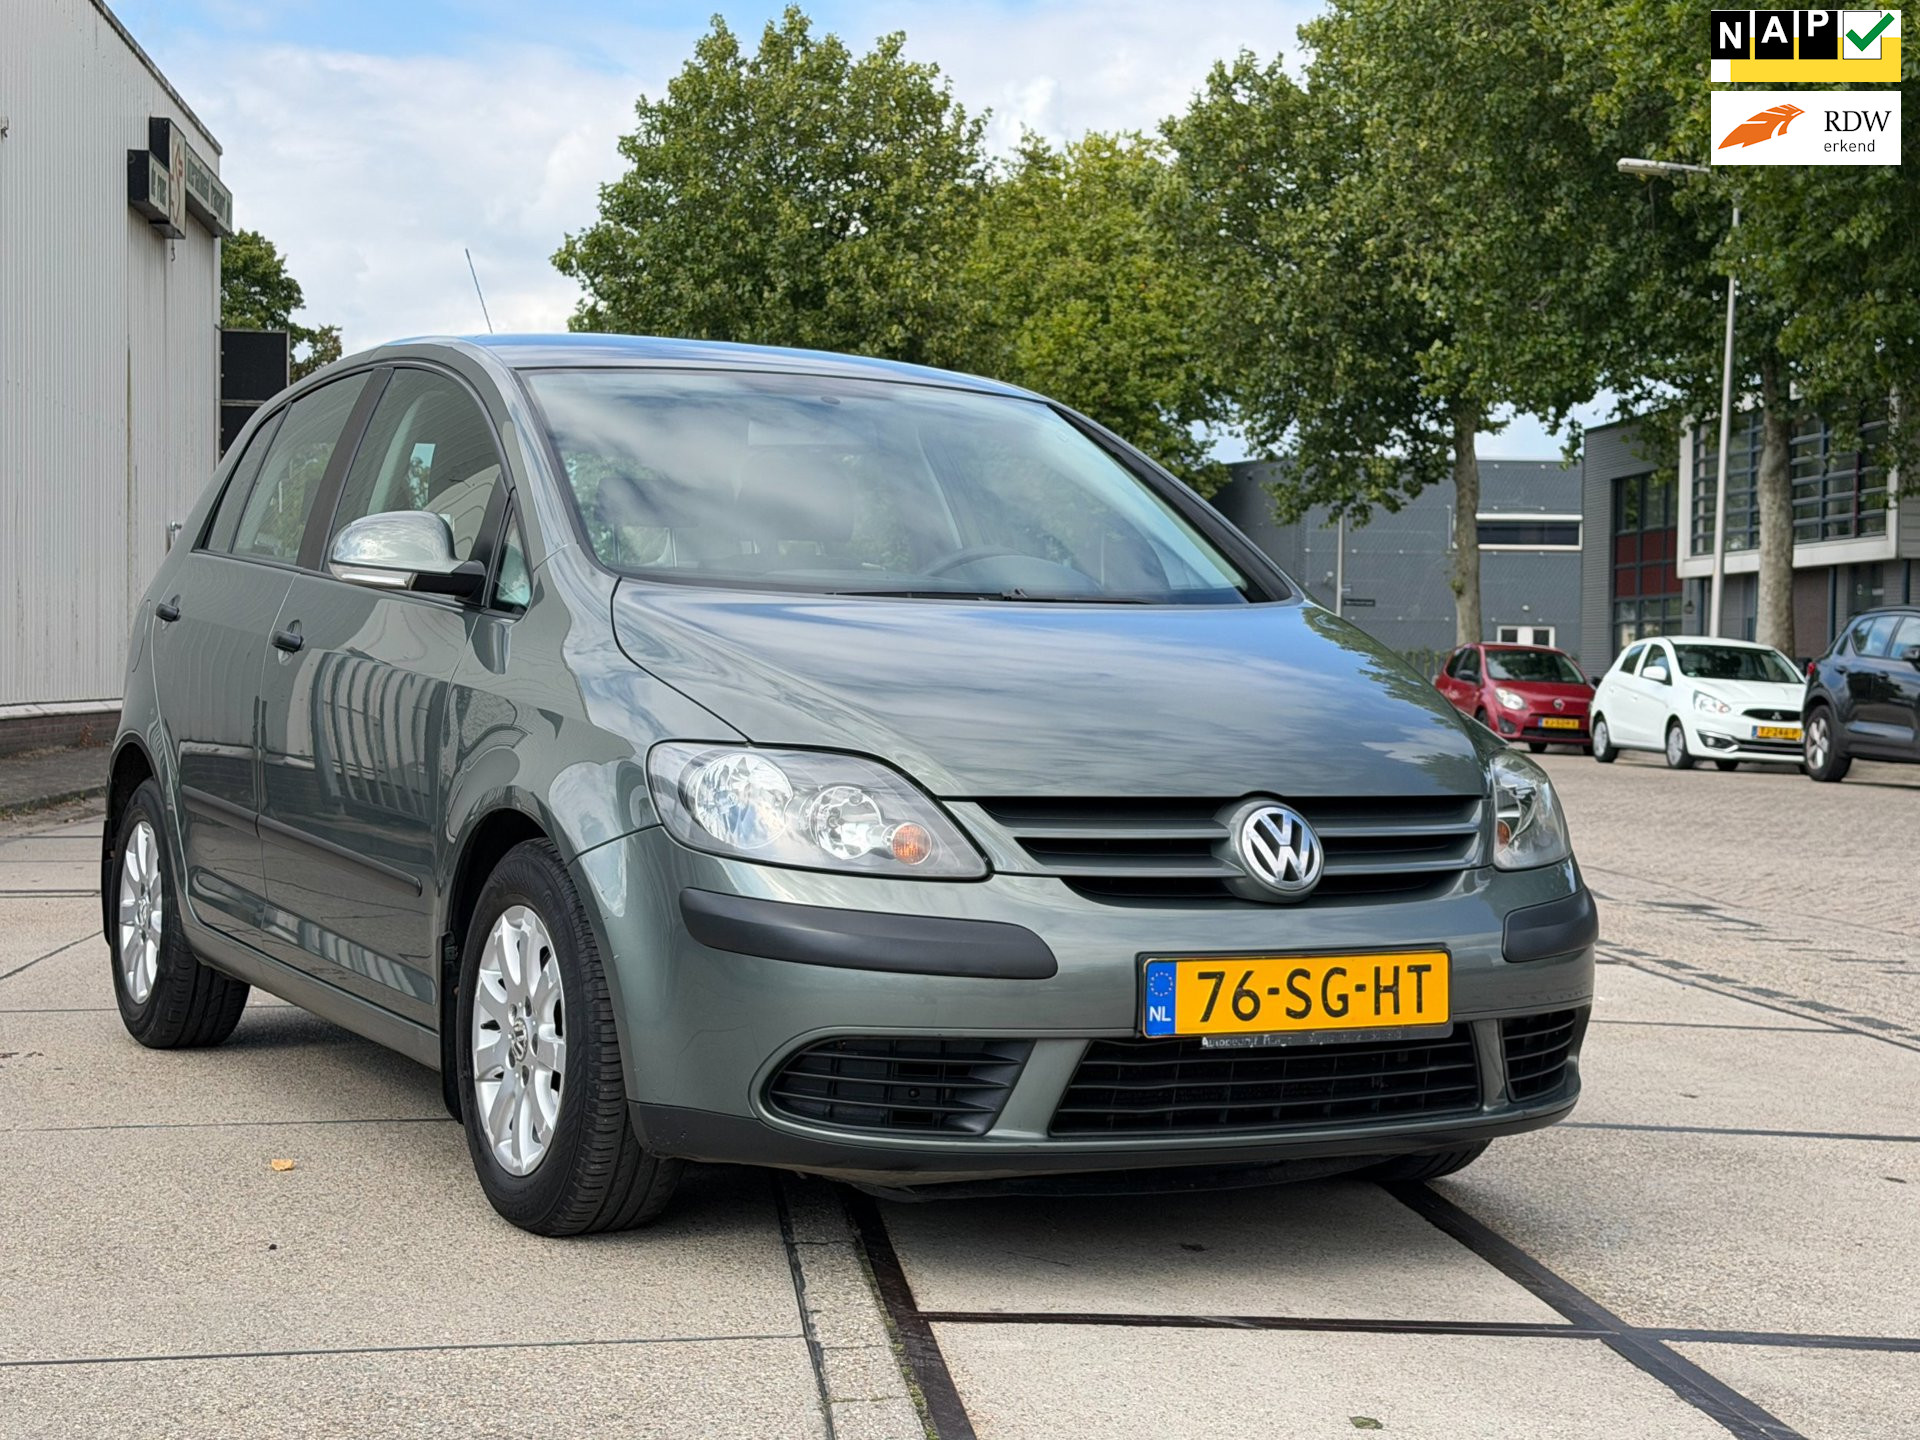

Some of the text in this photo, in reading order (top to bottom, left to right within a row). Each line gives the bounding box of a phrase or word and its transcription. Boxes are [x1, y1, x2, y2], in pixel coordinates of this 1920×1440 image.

[1242, 807, 1320, 888] VW
[1149, 1005, 1172, 1023] NL
[1197, 963, 1432, 1023] 76-SG-HT
